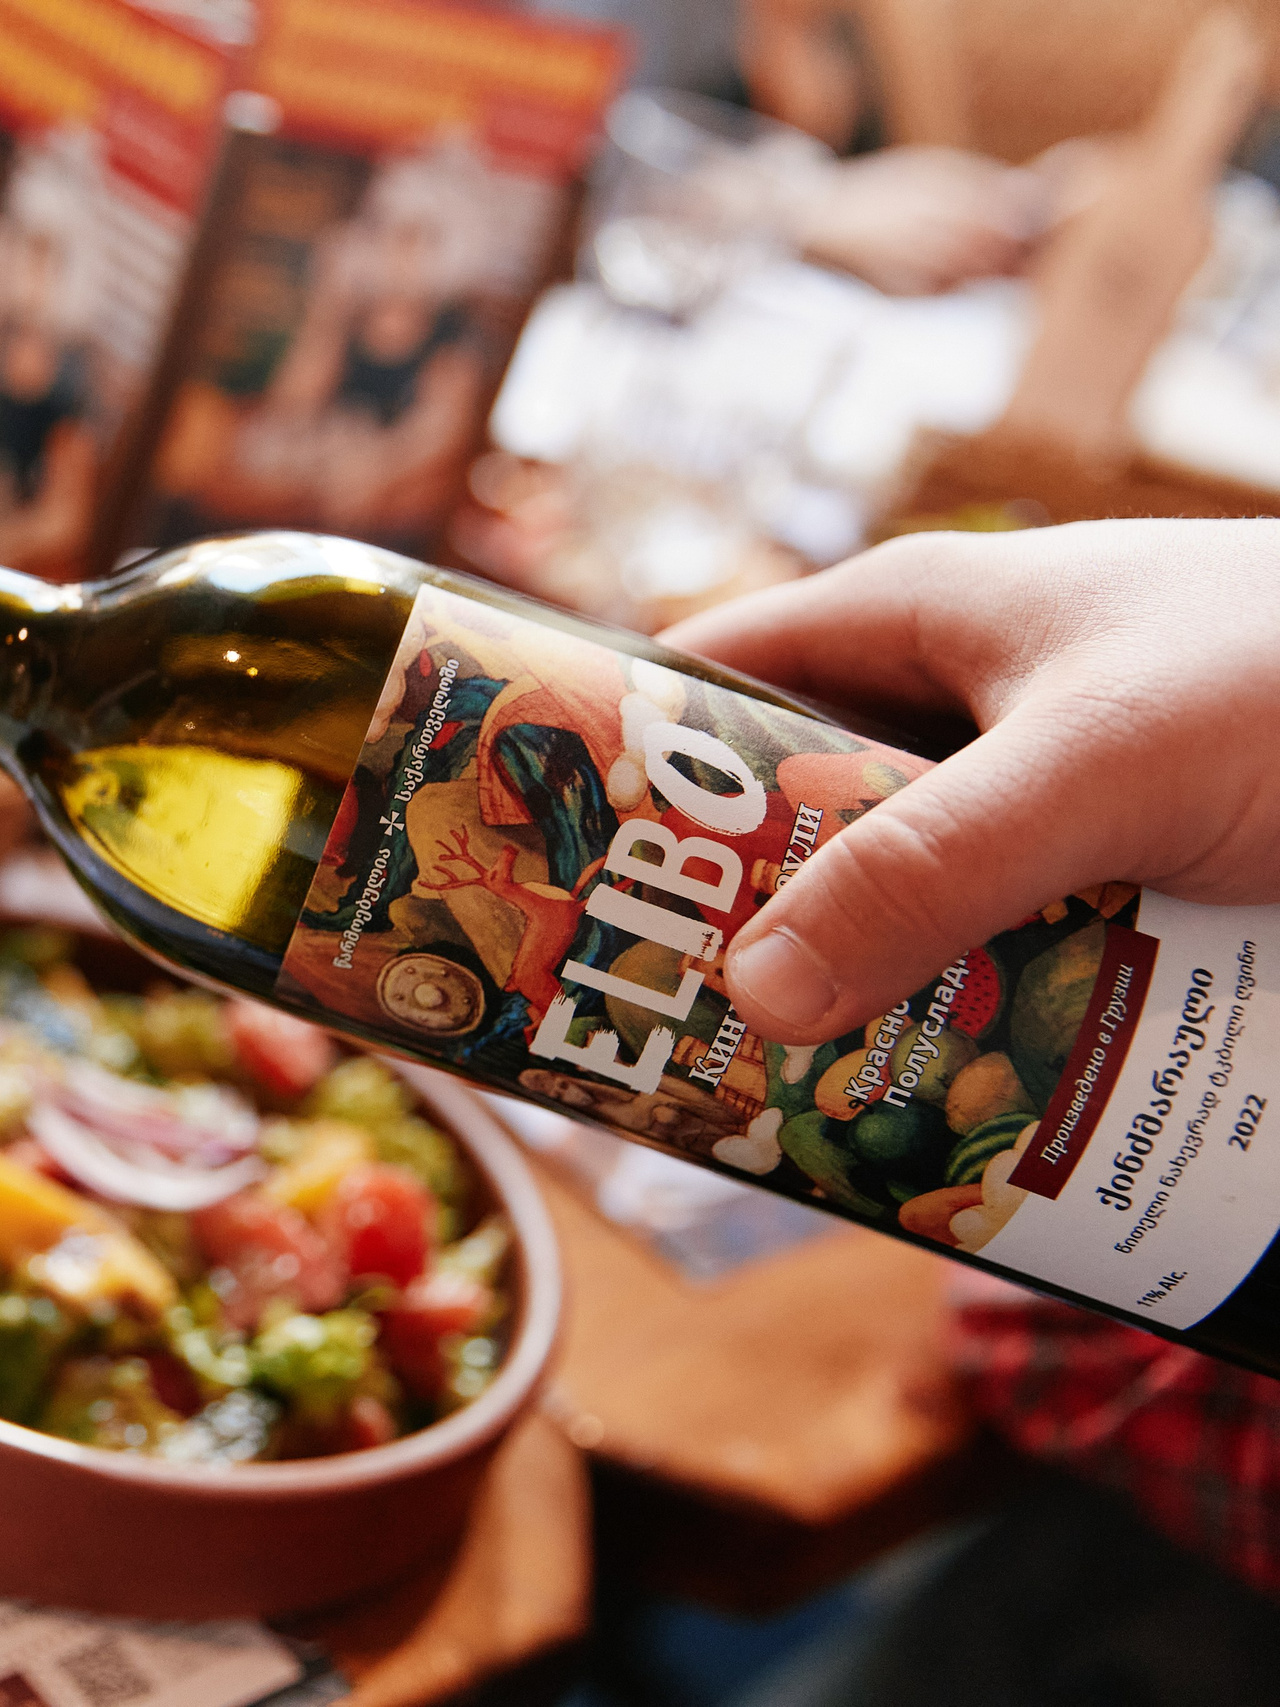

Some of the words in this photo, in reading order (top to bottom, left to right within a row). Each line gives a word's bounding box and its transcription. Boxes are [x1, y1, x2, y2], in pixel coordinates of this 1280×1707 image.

[394, 658, 460, 802] საქართველოში
[530, 721, 767, 1095] ELIBO
[844, 1000, 911, 1101] Красно
[882, 950, 970, 1108] Полуслад
[1098, 1031, 1113, 1046] в
[1099, 963, 1134, 1032] Грузии
[1040, 1047, 1107, 1166] Произведено
[1095, 968, 1215, 1211] ქინძმარაული
[1228, 1094, 1268, 1152] 2022
[1136, 1288, 1167, 1308] 11%
[1158, 1269, 1189, 1291] Alc.
